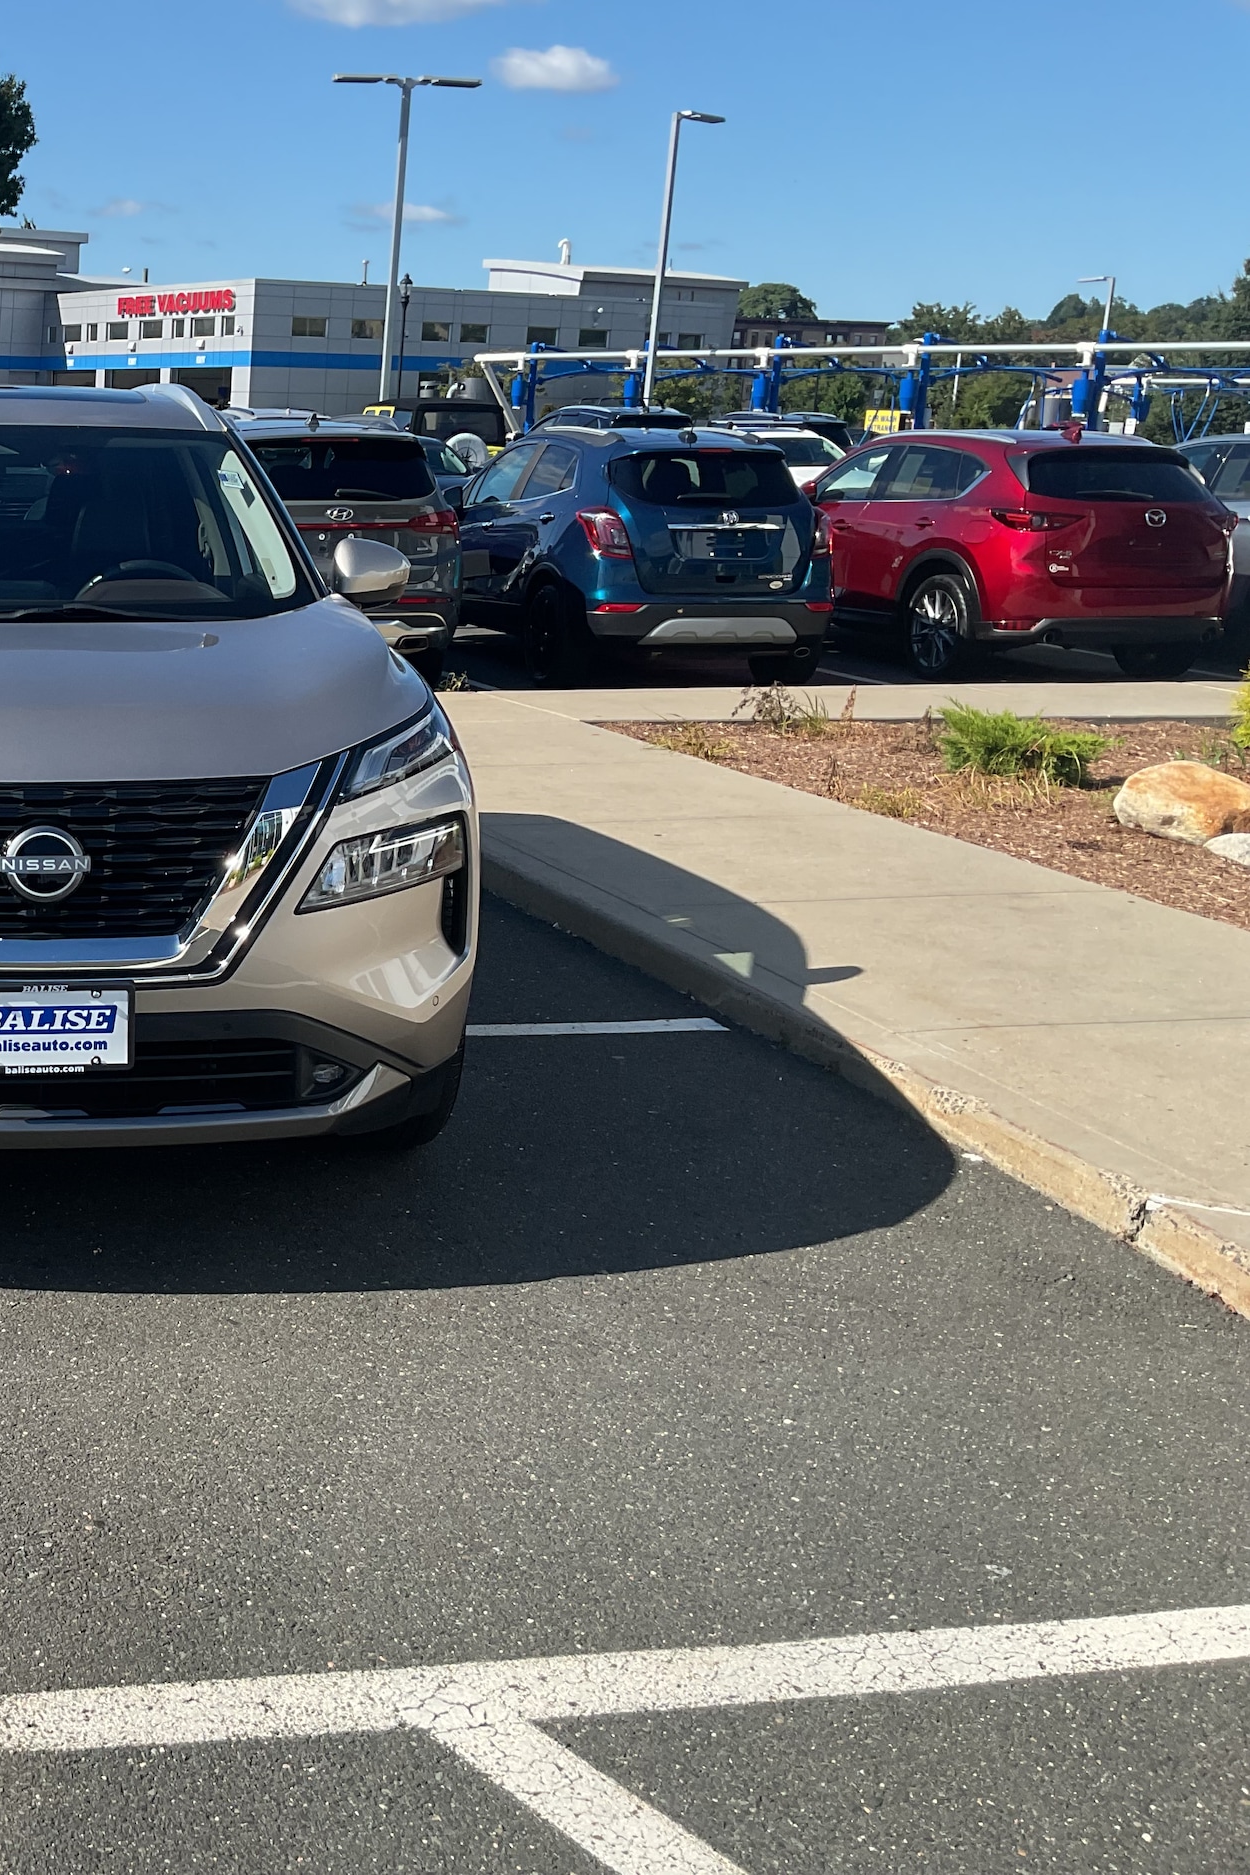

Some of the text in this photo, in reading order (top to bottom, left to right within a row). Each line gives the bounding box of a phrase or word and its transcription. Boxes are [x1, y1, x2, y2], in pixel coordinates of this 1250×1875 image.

[117, 288, 236, 316] FREE VACUUMS
[1, 859, 88, 871] NISSAN
[22, 984, 68, 993] BALISE
[4, 1065, 85, 1075] baliseauto.com
